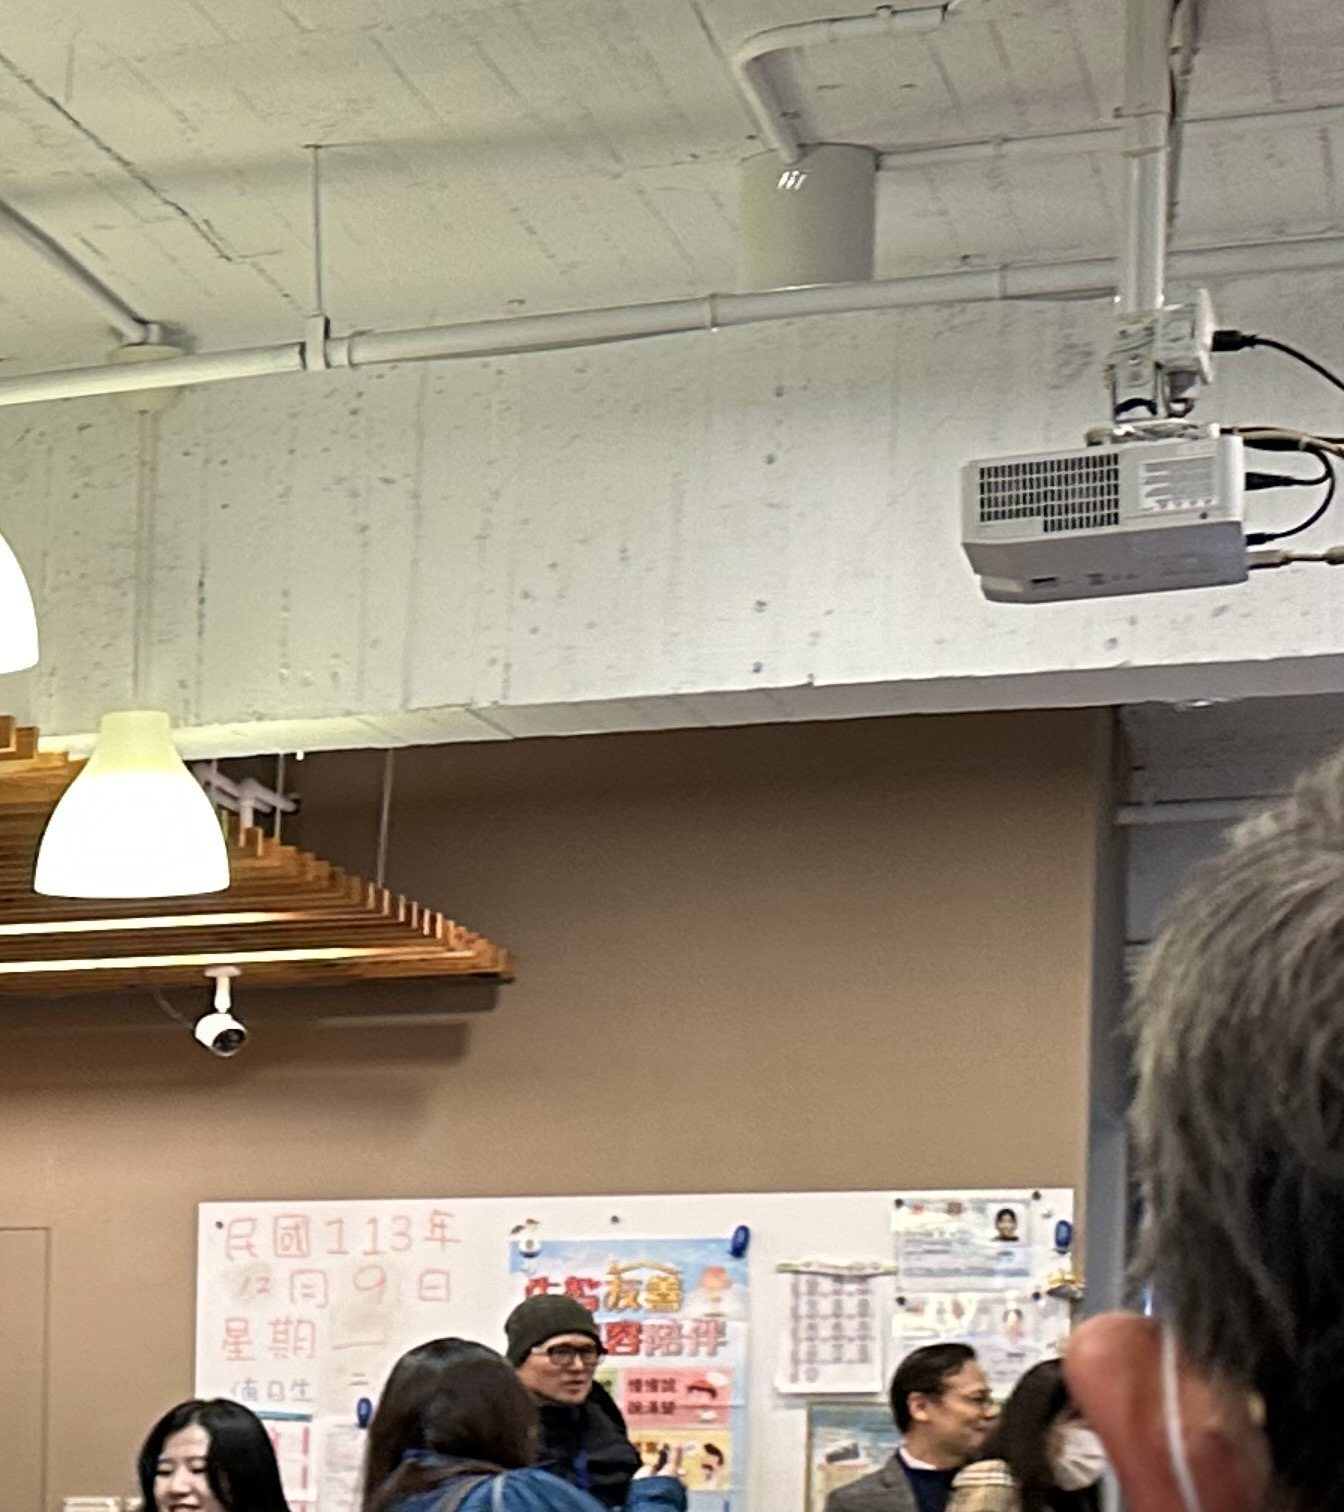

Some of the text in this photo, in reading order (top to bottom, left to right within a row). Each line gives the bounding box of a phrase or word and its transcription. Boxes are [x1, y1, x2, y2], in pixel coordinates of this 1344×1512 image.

[225, 1209, 462, 1261] 民國113年
[598, 1319, 727, 1357] 容陪伴
